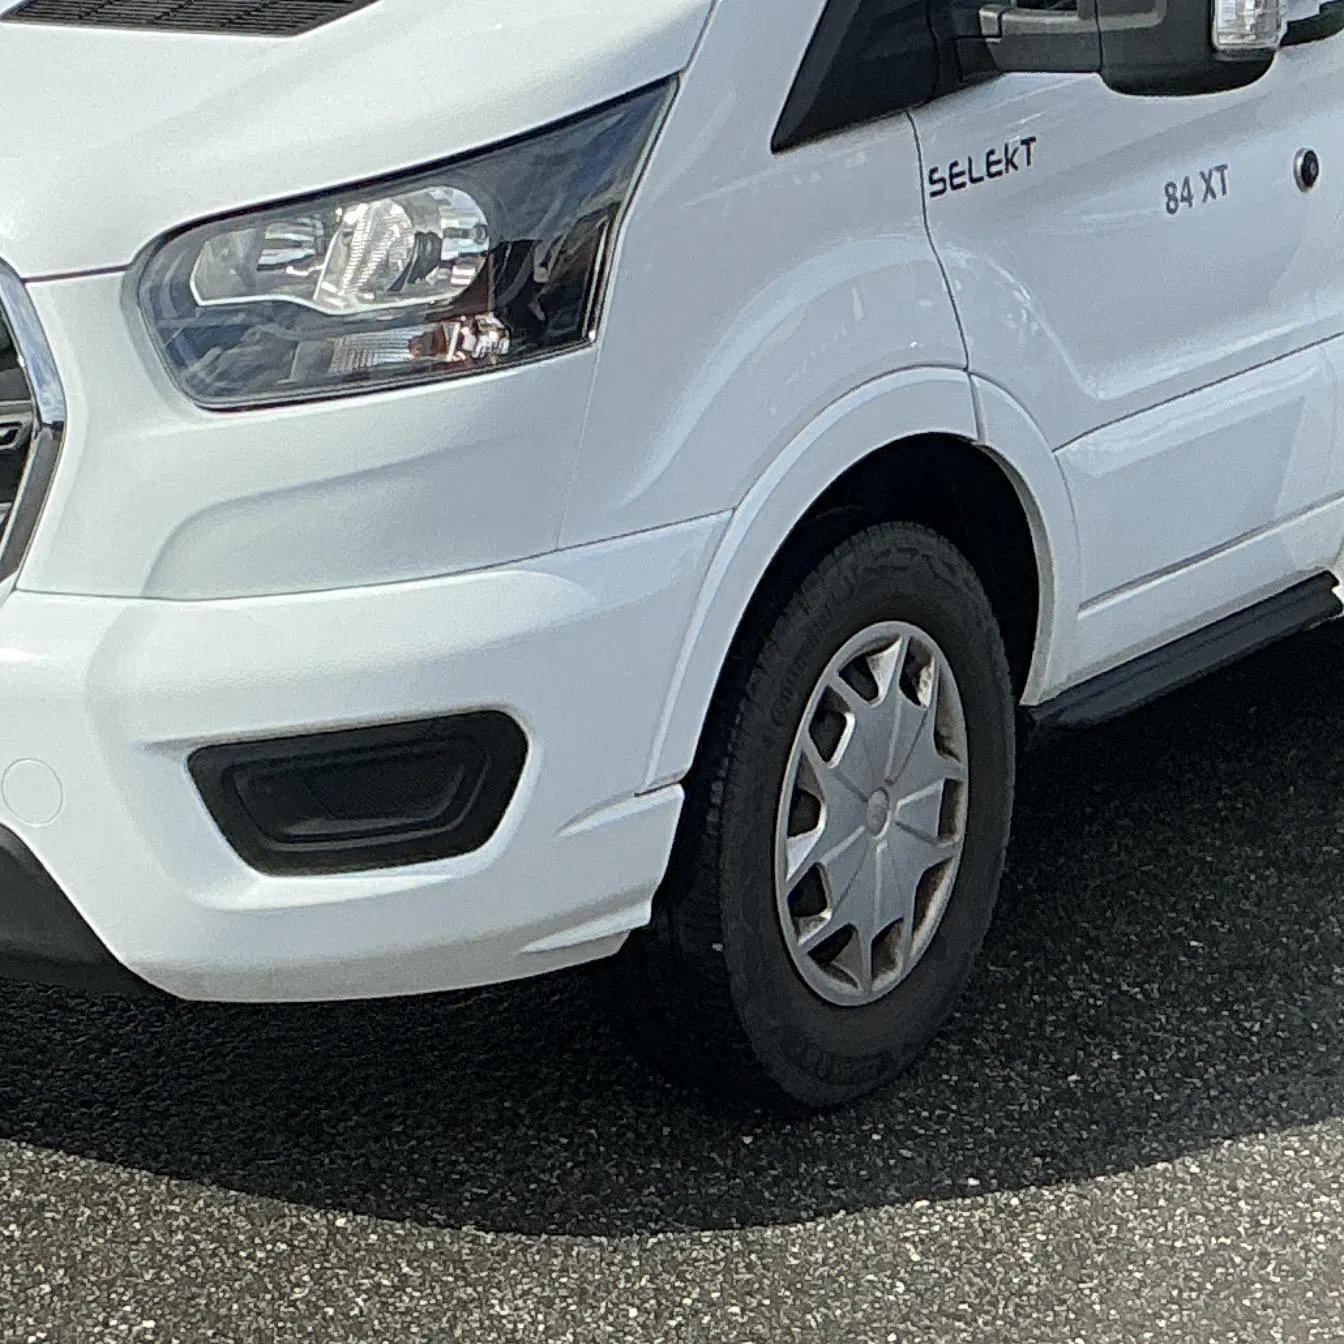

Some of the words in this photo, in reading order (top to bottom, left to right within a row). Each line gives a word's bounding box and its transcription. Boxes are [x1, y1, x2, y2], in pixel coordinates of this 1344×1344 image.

[928, 137, 1037, 198] SELEKT
[1163, 176, 1194, 215] 84
[1200, 164, 1230, 204] XT
